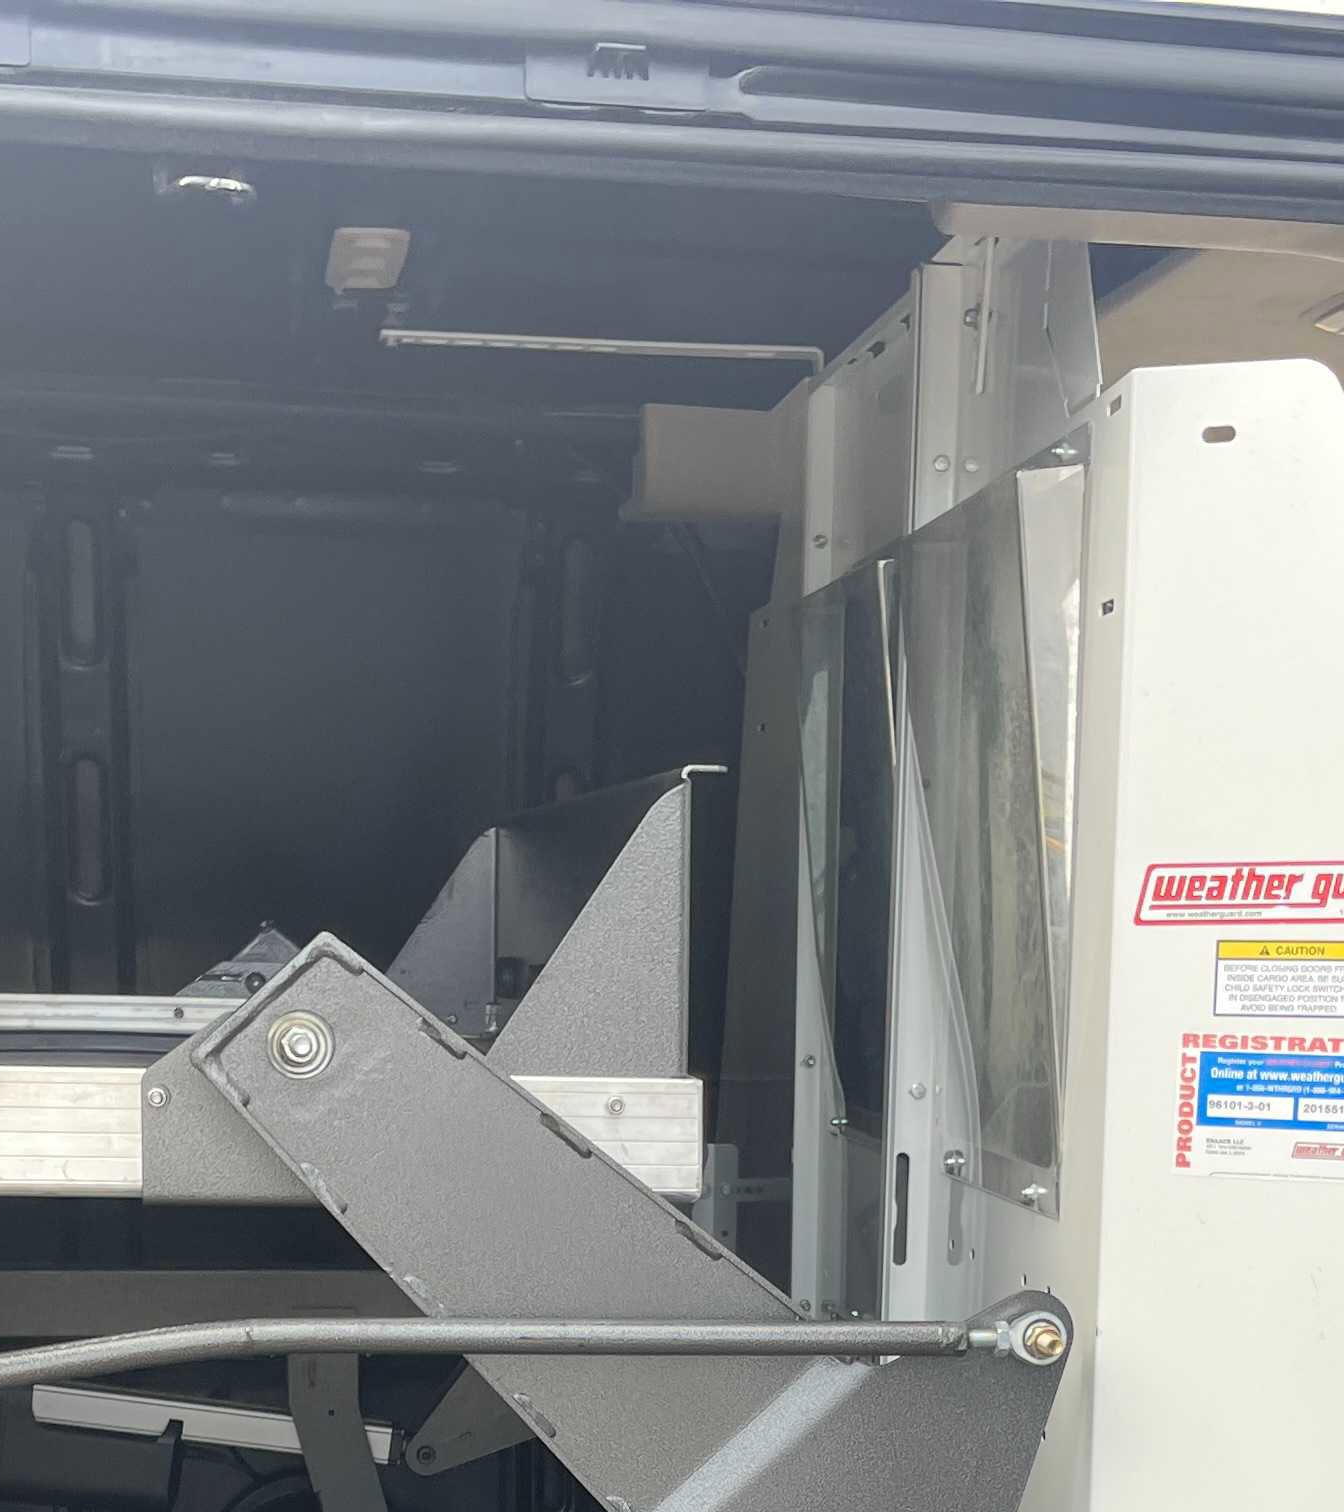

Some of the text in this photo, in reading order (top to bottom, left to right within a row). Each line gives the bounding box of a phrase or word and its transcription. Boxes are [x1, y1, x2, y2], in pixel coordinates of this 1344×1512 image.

[1152, 868, 1304, 901] weather
[1276, 945, 1325, 956] CAUTION
[1224, 964, 1258, 972] BEFORE
[1224, 984, 1250, 992] CHILD
[1252, 984, 1285, 992] SAFETY
[1287, 984, 1311, 992] LOCK
[1211, 1067, 1244, 1080] Online
[1247, 1069, 1257, 1080] at
[1176, 1052, 1196, 1168] PRODUCT
